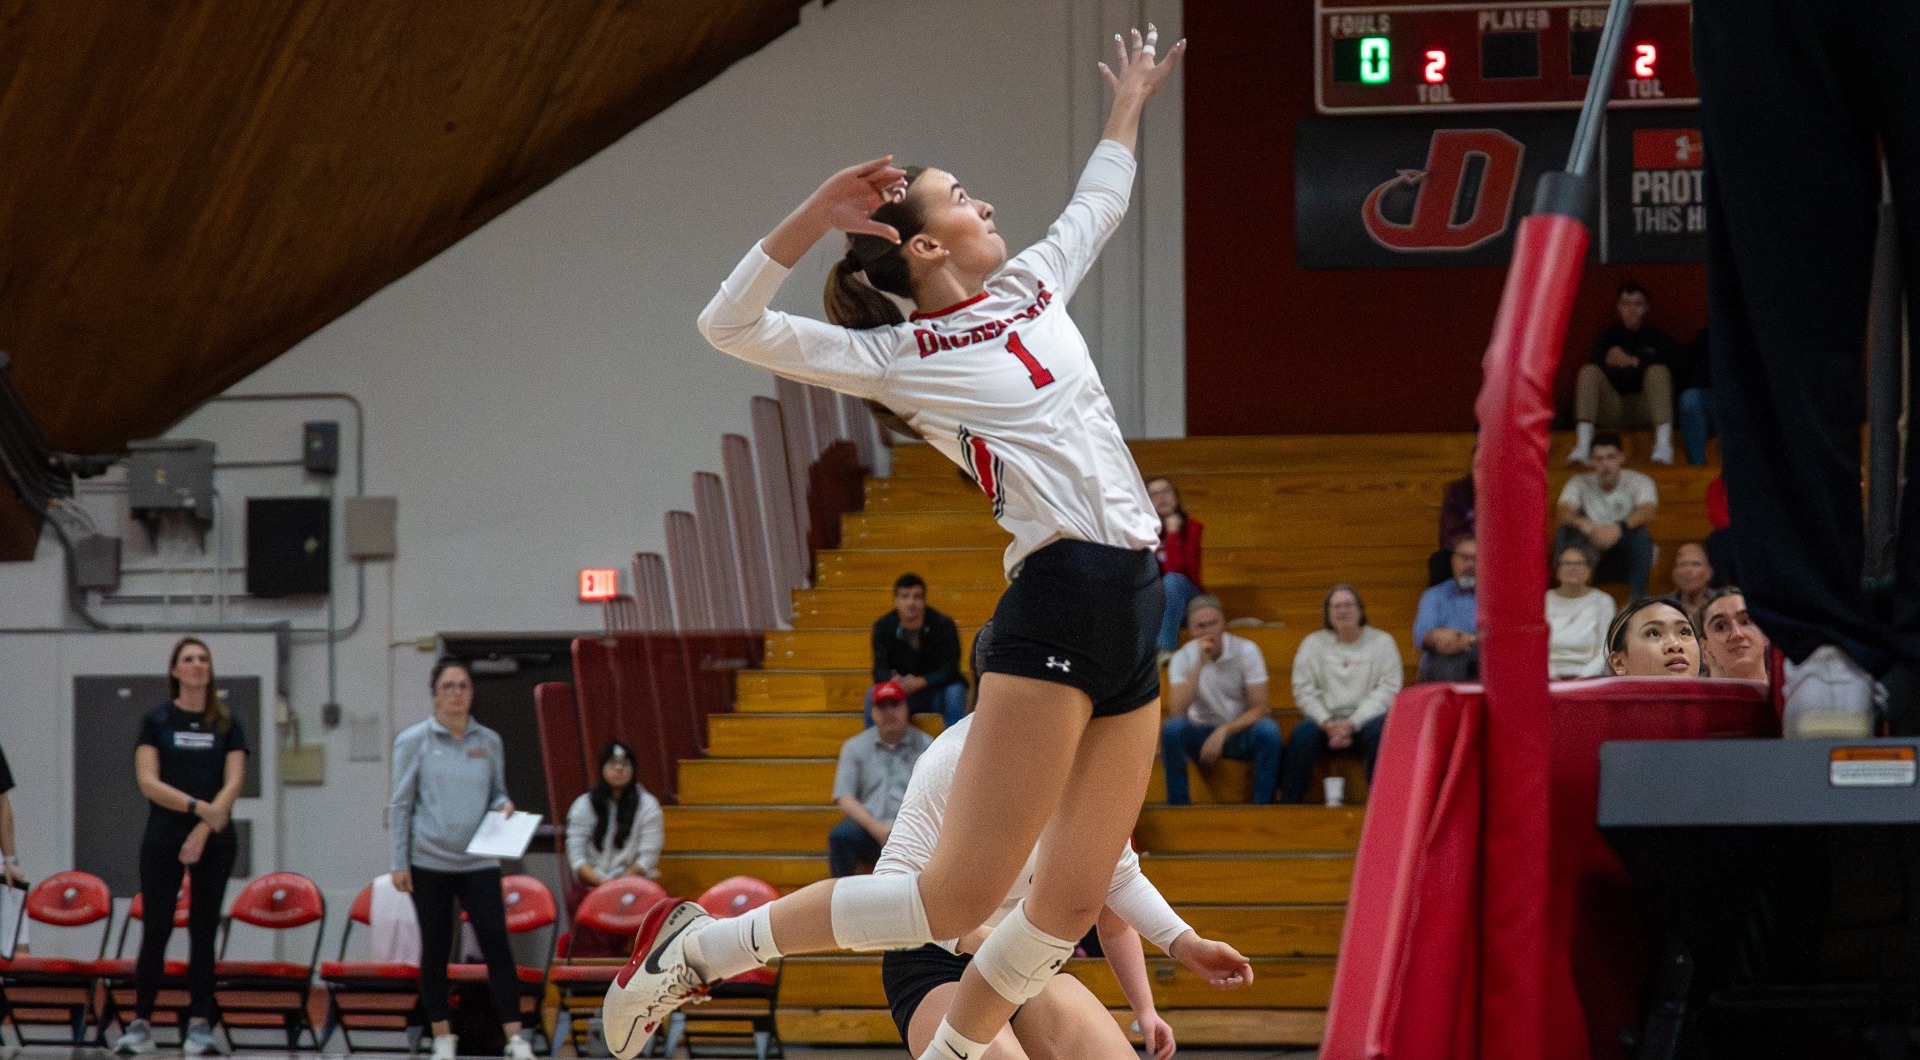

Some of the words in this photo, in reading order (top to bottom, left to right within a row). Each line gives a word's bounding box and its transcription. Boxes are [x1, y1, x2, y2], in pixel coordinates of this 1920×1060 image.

[1329, 14, 1391, 35] FOULS
[1478, 9, 1550, 31] PLAYER
[1360, 37, 1390, 84] 0
[1424, 50, 1446, 83] 2
[1634, 44, 1656, 77] 2
[1417, 83, 1454, 103] TOL
[1627, 78, 1665, 98] TOL
[1634, 206, 1682, 232] THIS
[1004, 330, 1055, 390] 1
